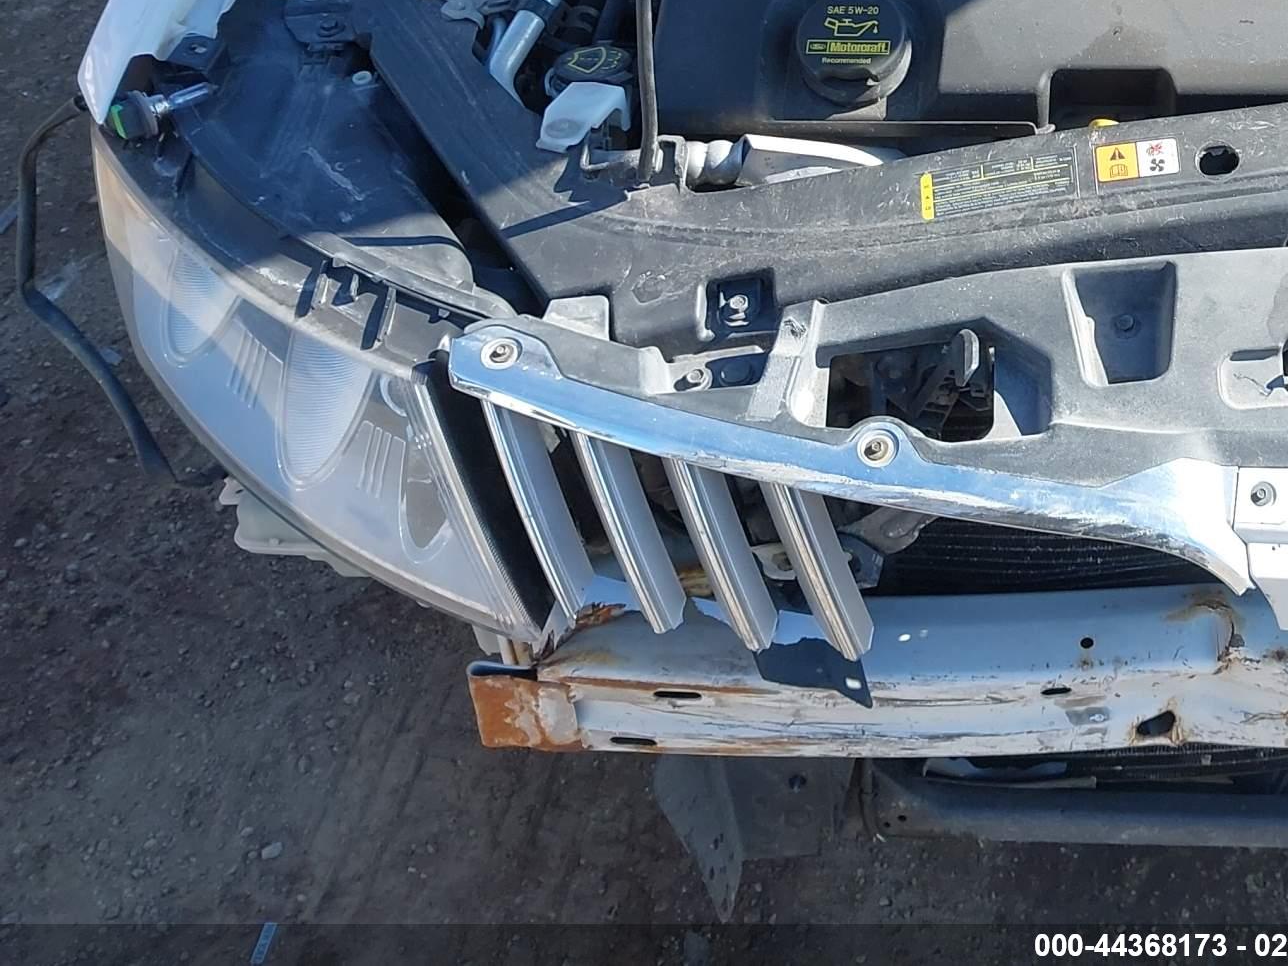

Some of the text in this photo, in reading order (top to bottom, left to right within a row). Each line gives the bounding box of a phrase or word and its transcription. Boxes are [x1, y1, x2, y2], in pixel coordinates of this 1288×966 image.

[826, 5, 880, 15] SAE 5W-20
[829, 41, 888, 53] Motorcraft
